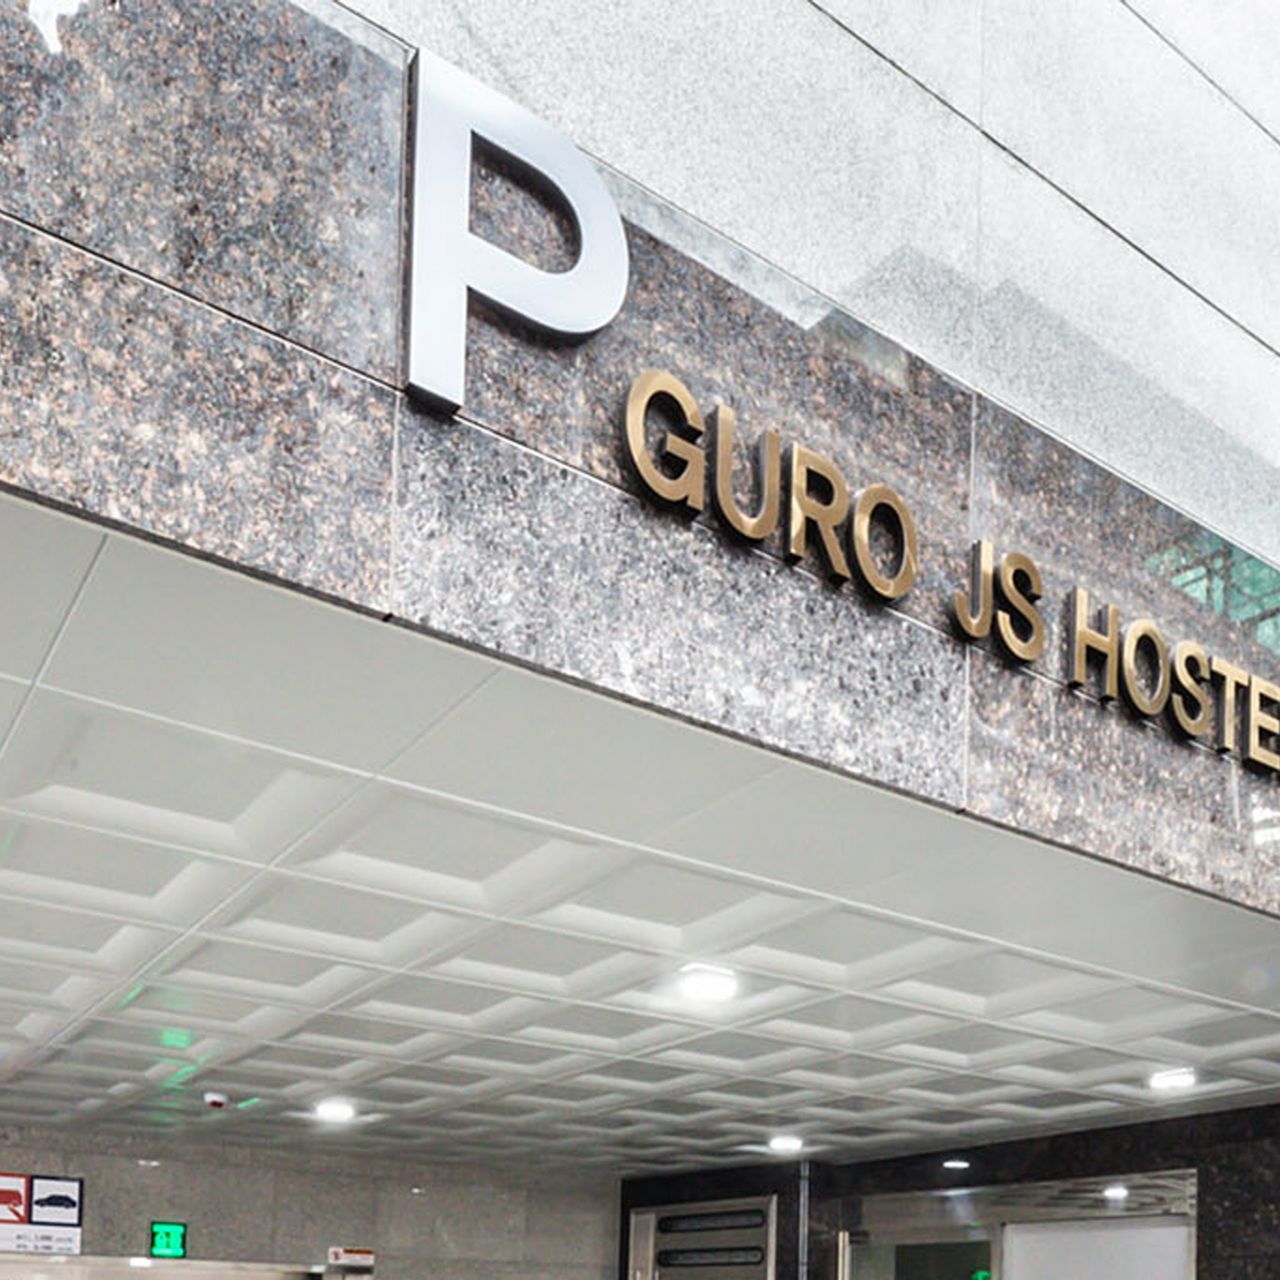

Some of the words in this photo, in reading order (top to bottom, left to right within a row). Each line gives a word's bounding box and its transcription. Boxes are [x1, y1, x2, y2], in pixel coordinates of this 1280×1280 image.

[406, 47, 630, 408] P
[625, 369, 919, 600] GURO
[954, 539, 1045, 661] JS
